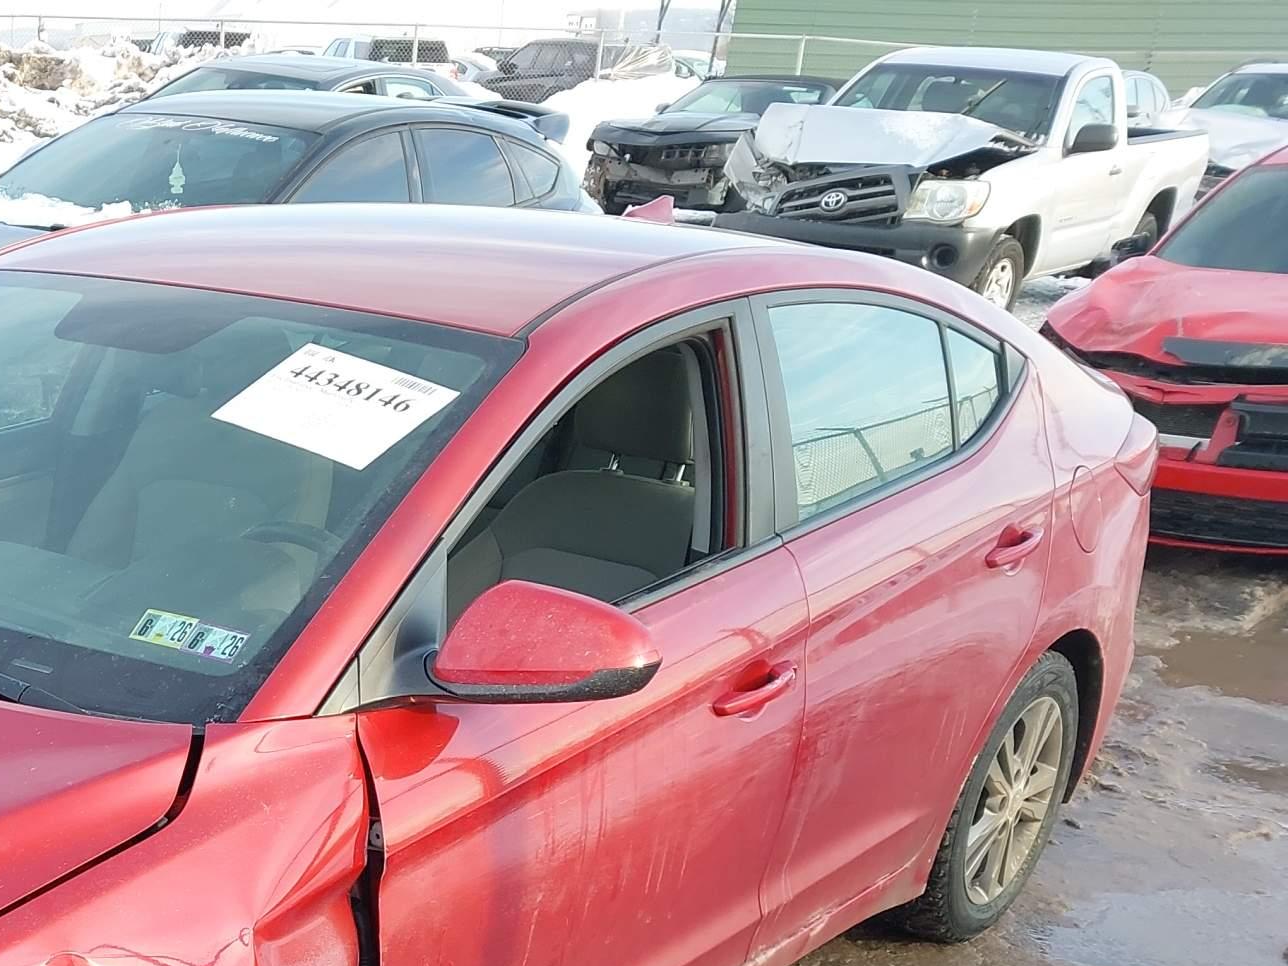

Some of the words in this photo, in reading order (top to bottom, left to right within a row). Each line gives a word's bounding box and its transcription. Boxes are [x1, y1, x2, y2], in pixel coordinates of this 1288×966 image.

[290, 365, 411, 413] 44348146
[138, 618, 154, 636] 6
[170, 621, 193, 643] 26
[188, 631, 204, 650] 6
[221, 635, 245, 657] 26
